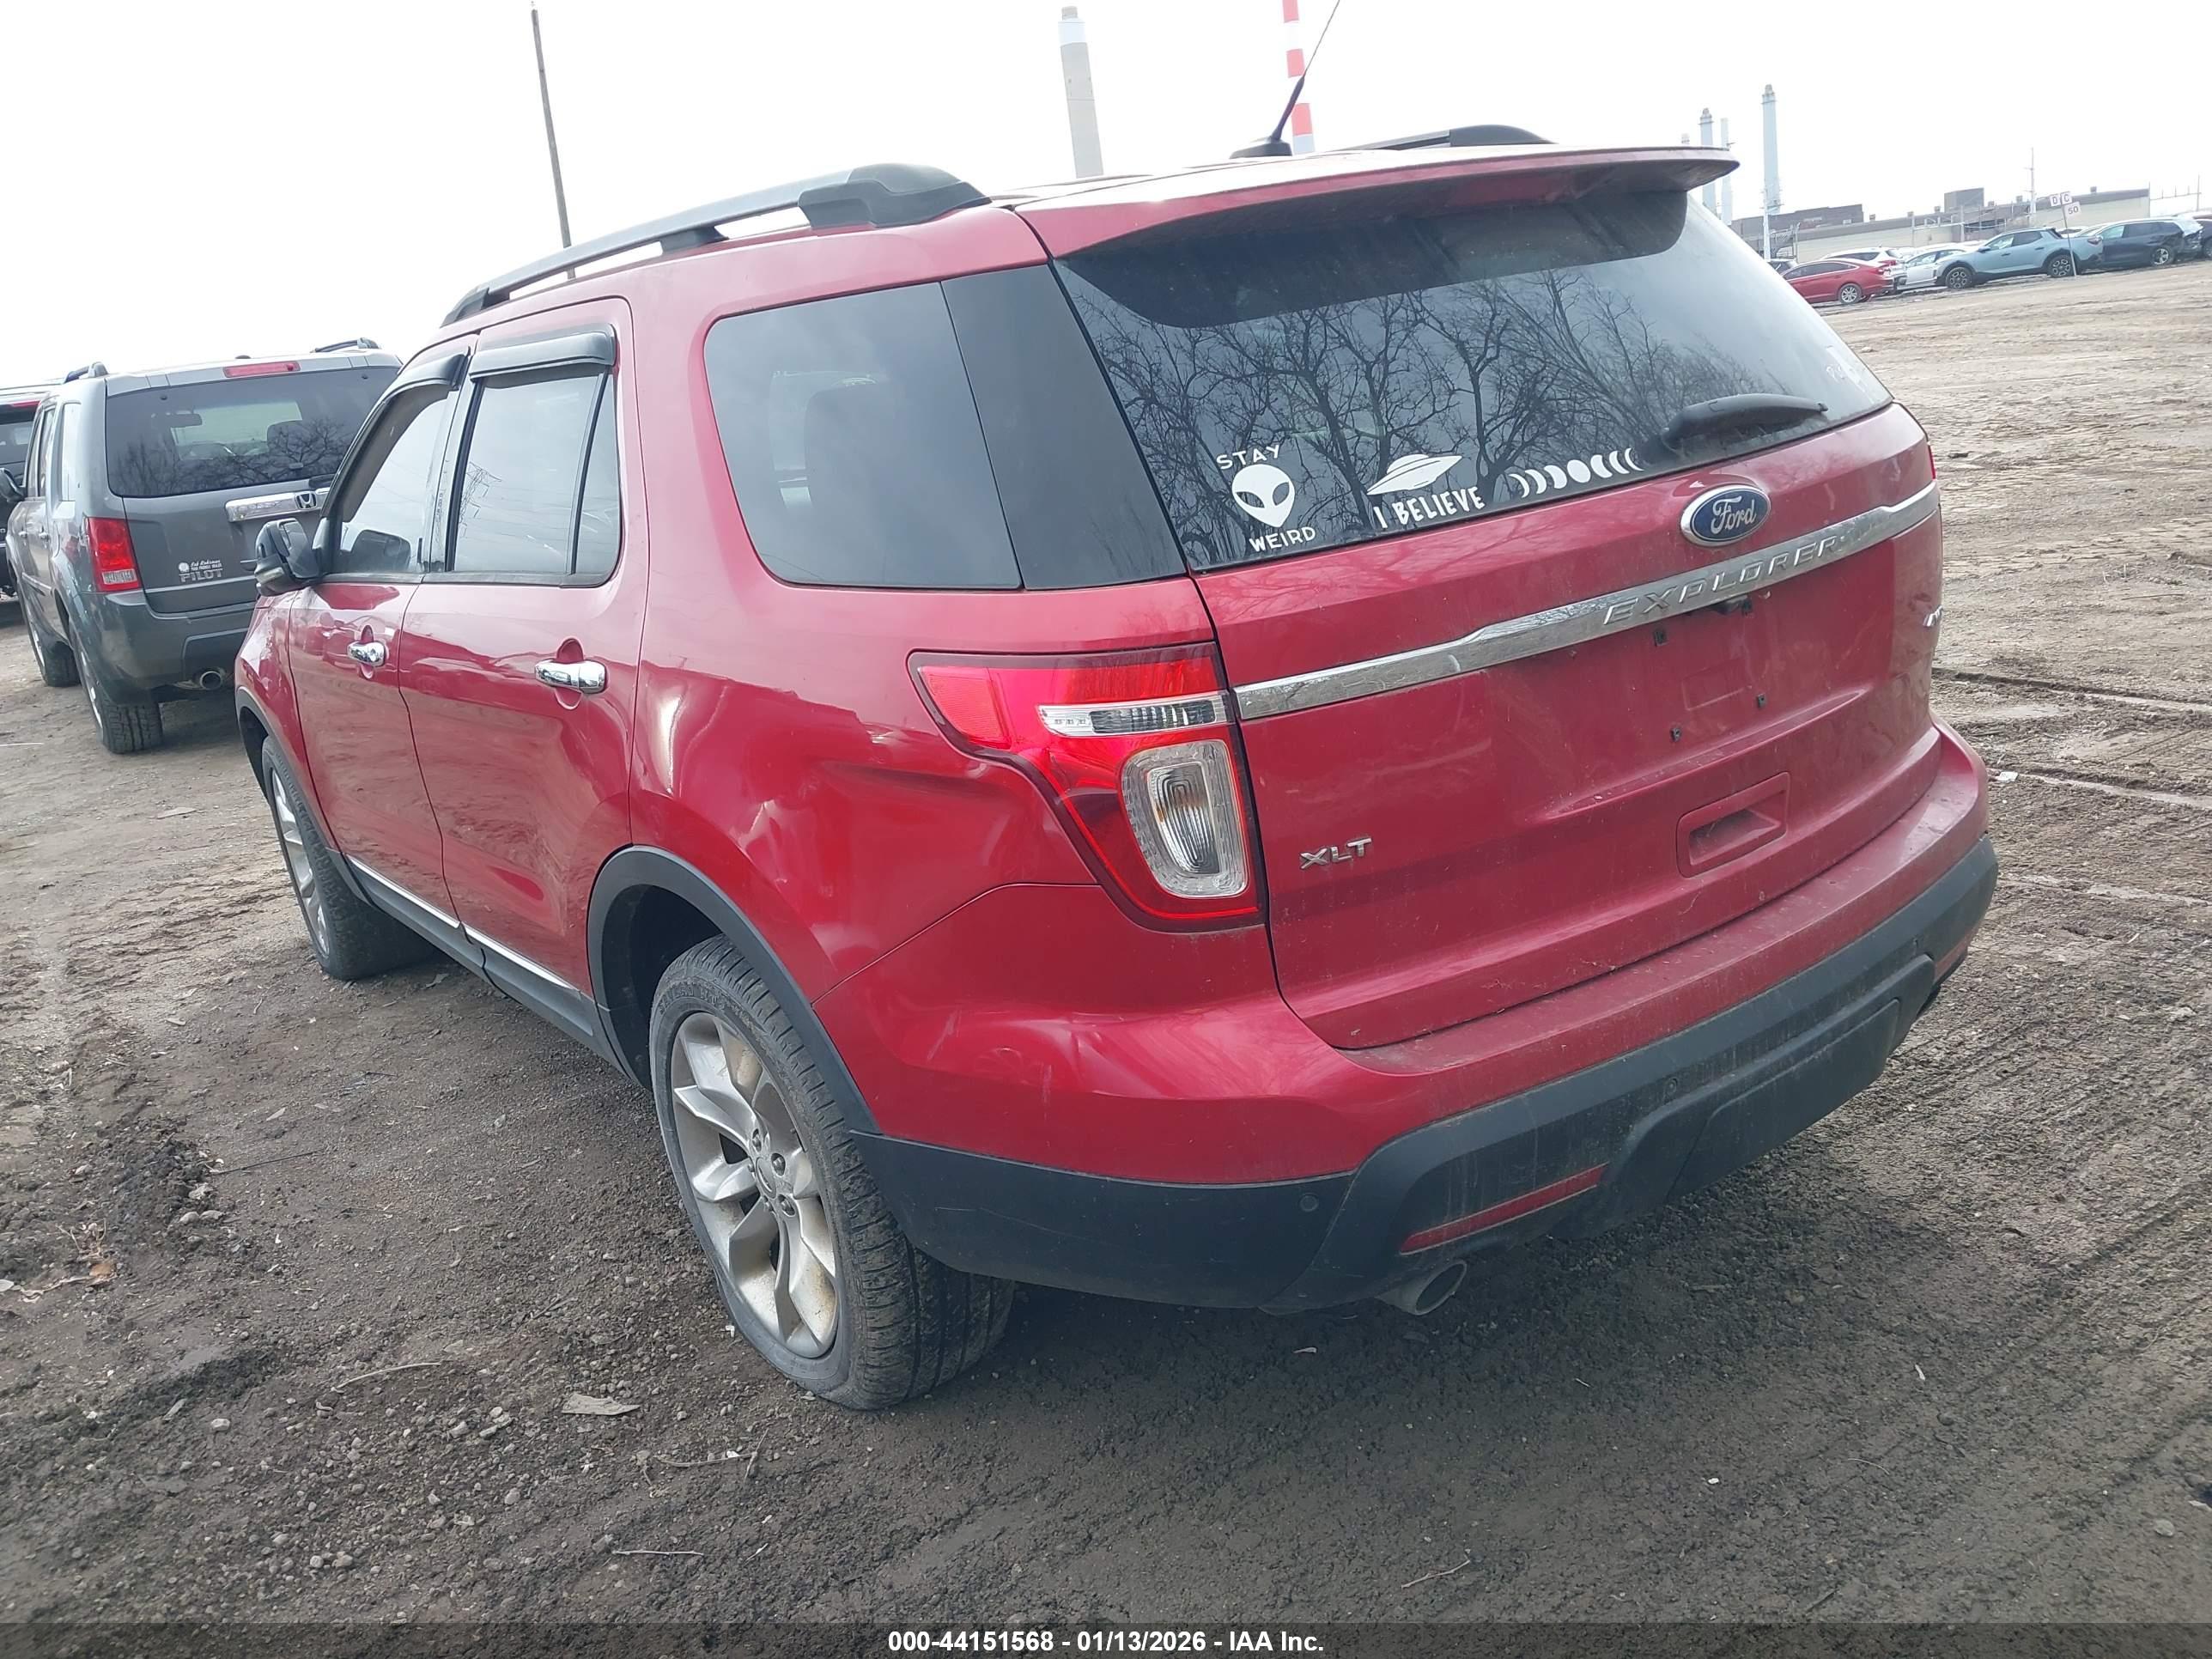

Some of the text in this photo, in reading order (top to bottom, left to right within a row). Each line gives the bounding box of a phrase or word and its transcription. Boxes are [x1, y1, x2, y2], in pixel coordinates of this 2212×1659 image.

[1216, 444, 1279, 470] STAY
[1373, 486, 1485, 528] I BELIEVE
[1711, 495, 1757, 534] Ford
[1249, 526, 1316, 552] WEIRD
[179, 568, 223, 582] PILOT
[1603, 535, 1838, 625] EXPLORER
[1299, 837, 1372, 870] XLT
